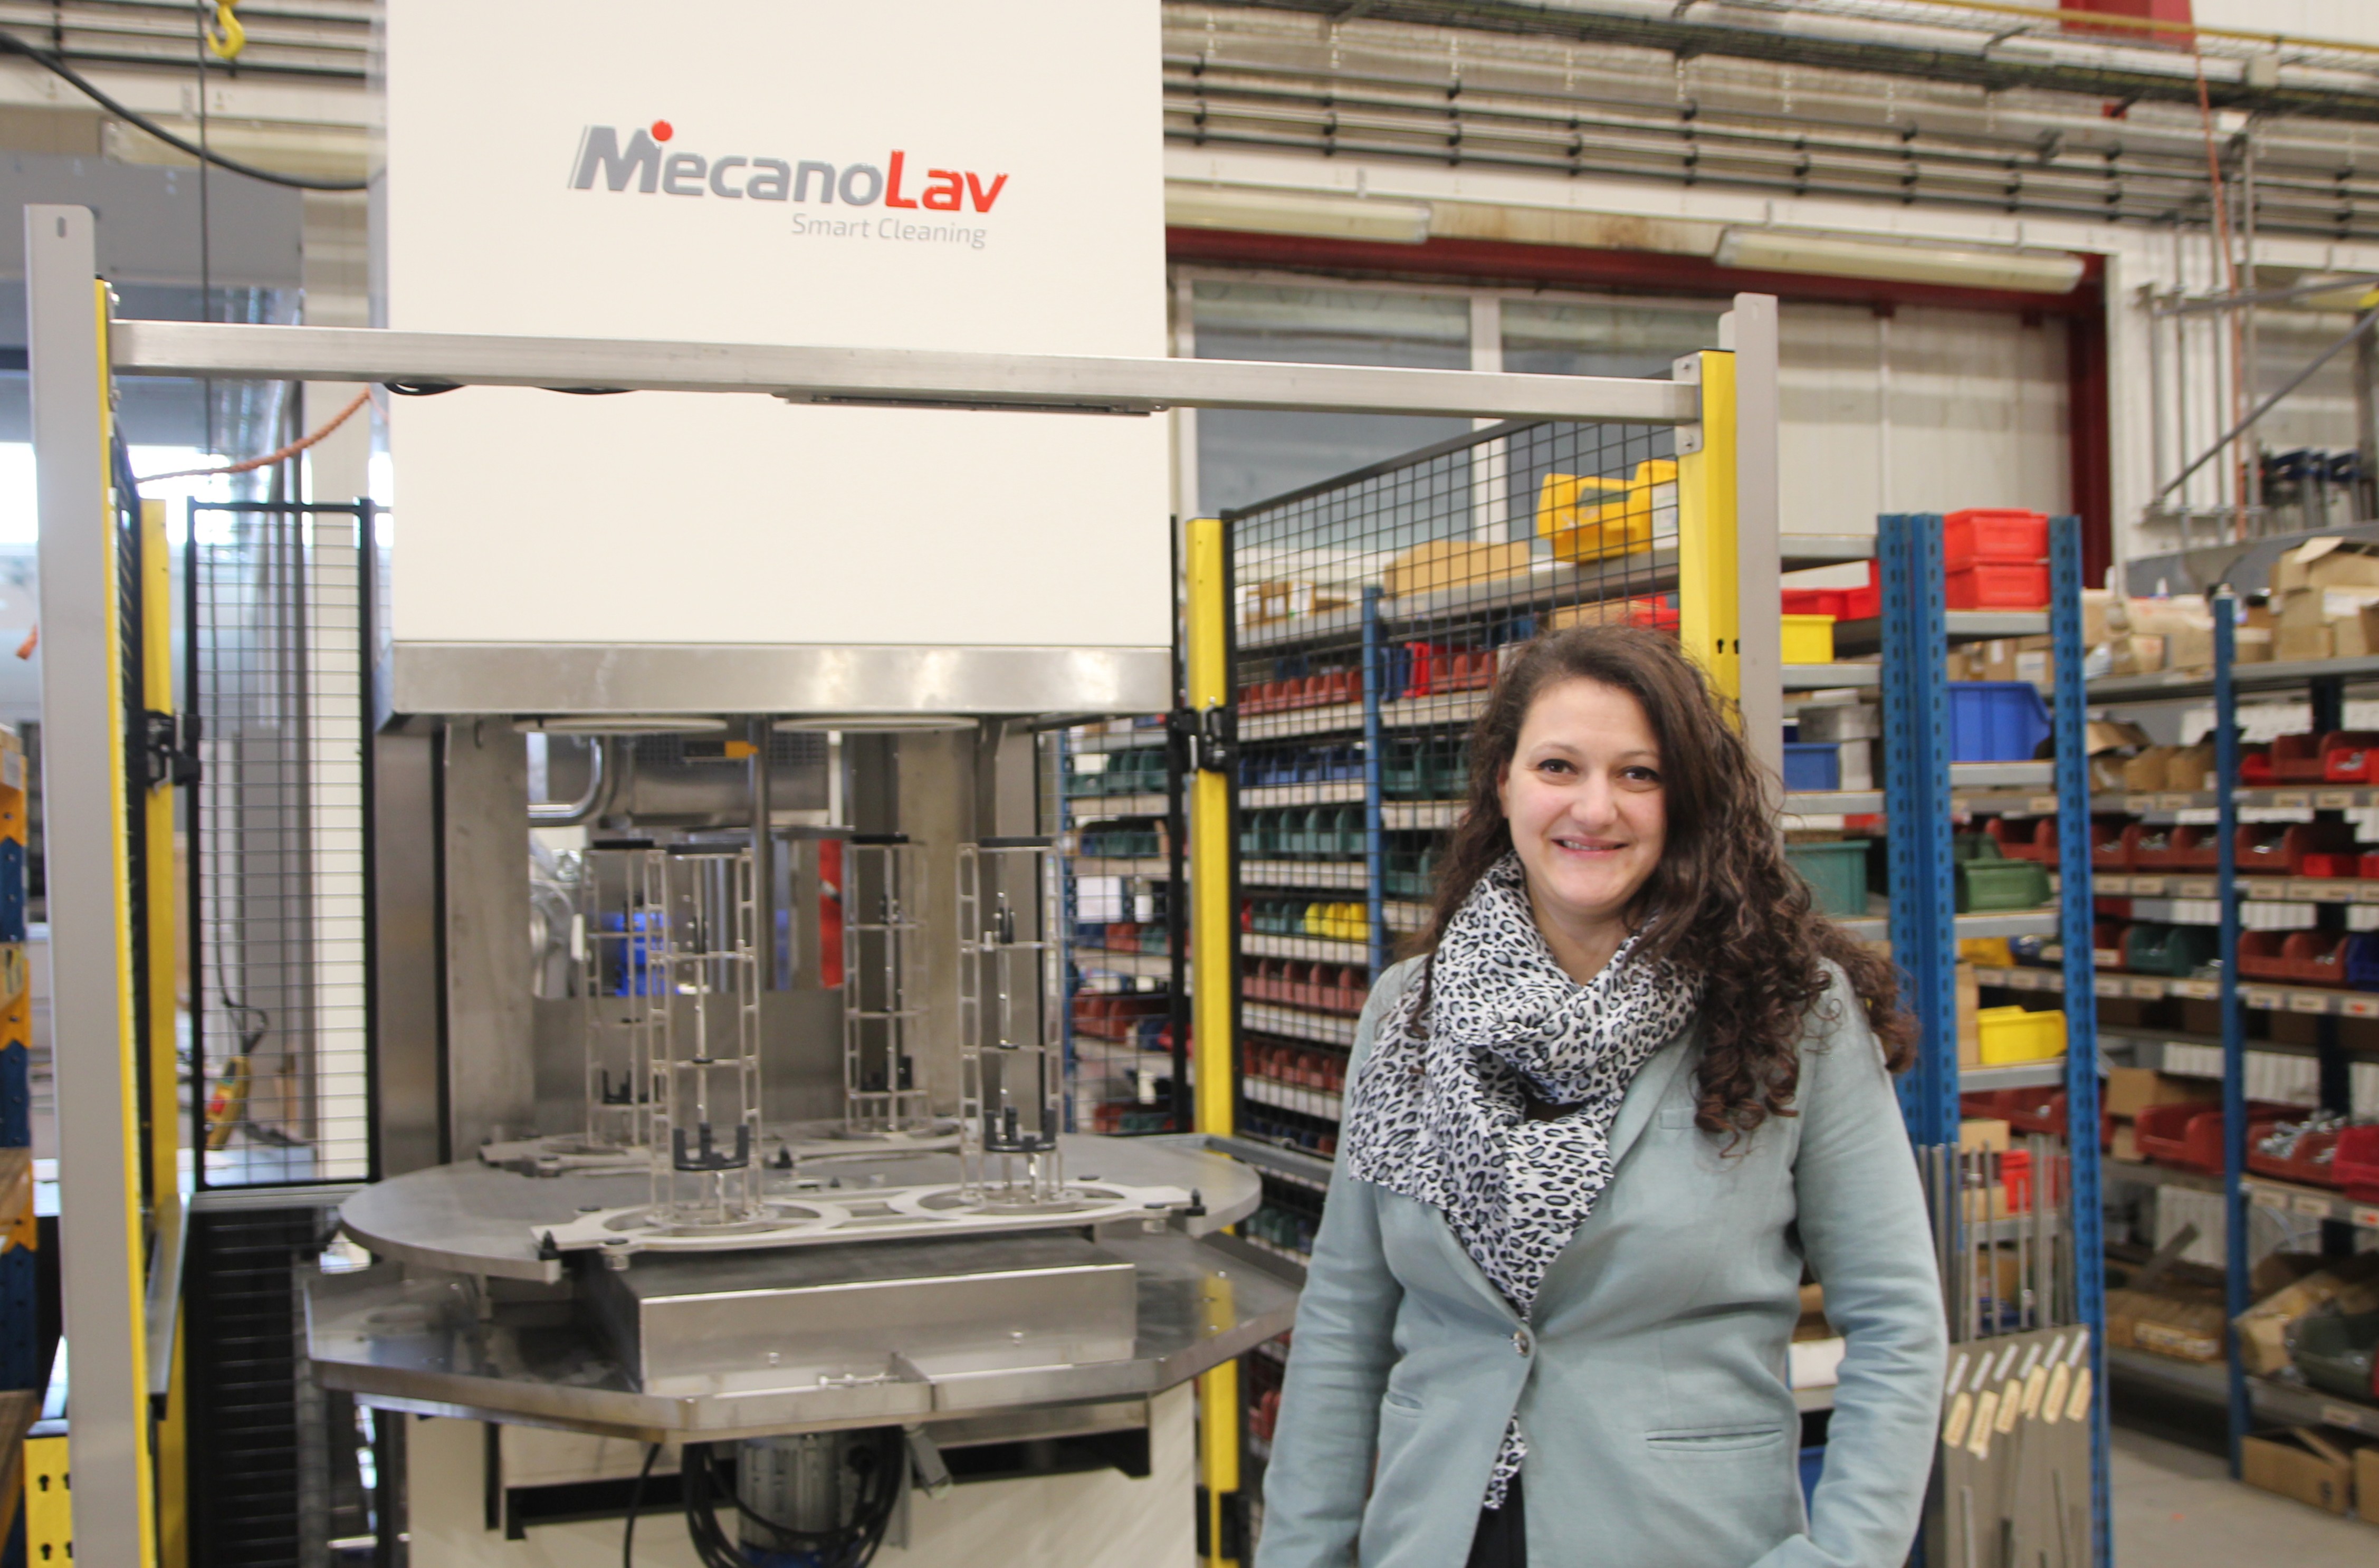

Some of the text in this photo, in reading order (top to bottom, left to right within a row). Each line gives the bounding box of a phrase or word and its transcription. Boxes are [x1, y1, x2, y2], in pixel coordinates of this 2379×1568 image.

[568, 120, 1008, 213] MecanoLav
[792, 213, 986, 248] Smart Cleaning
